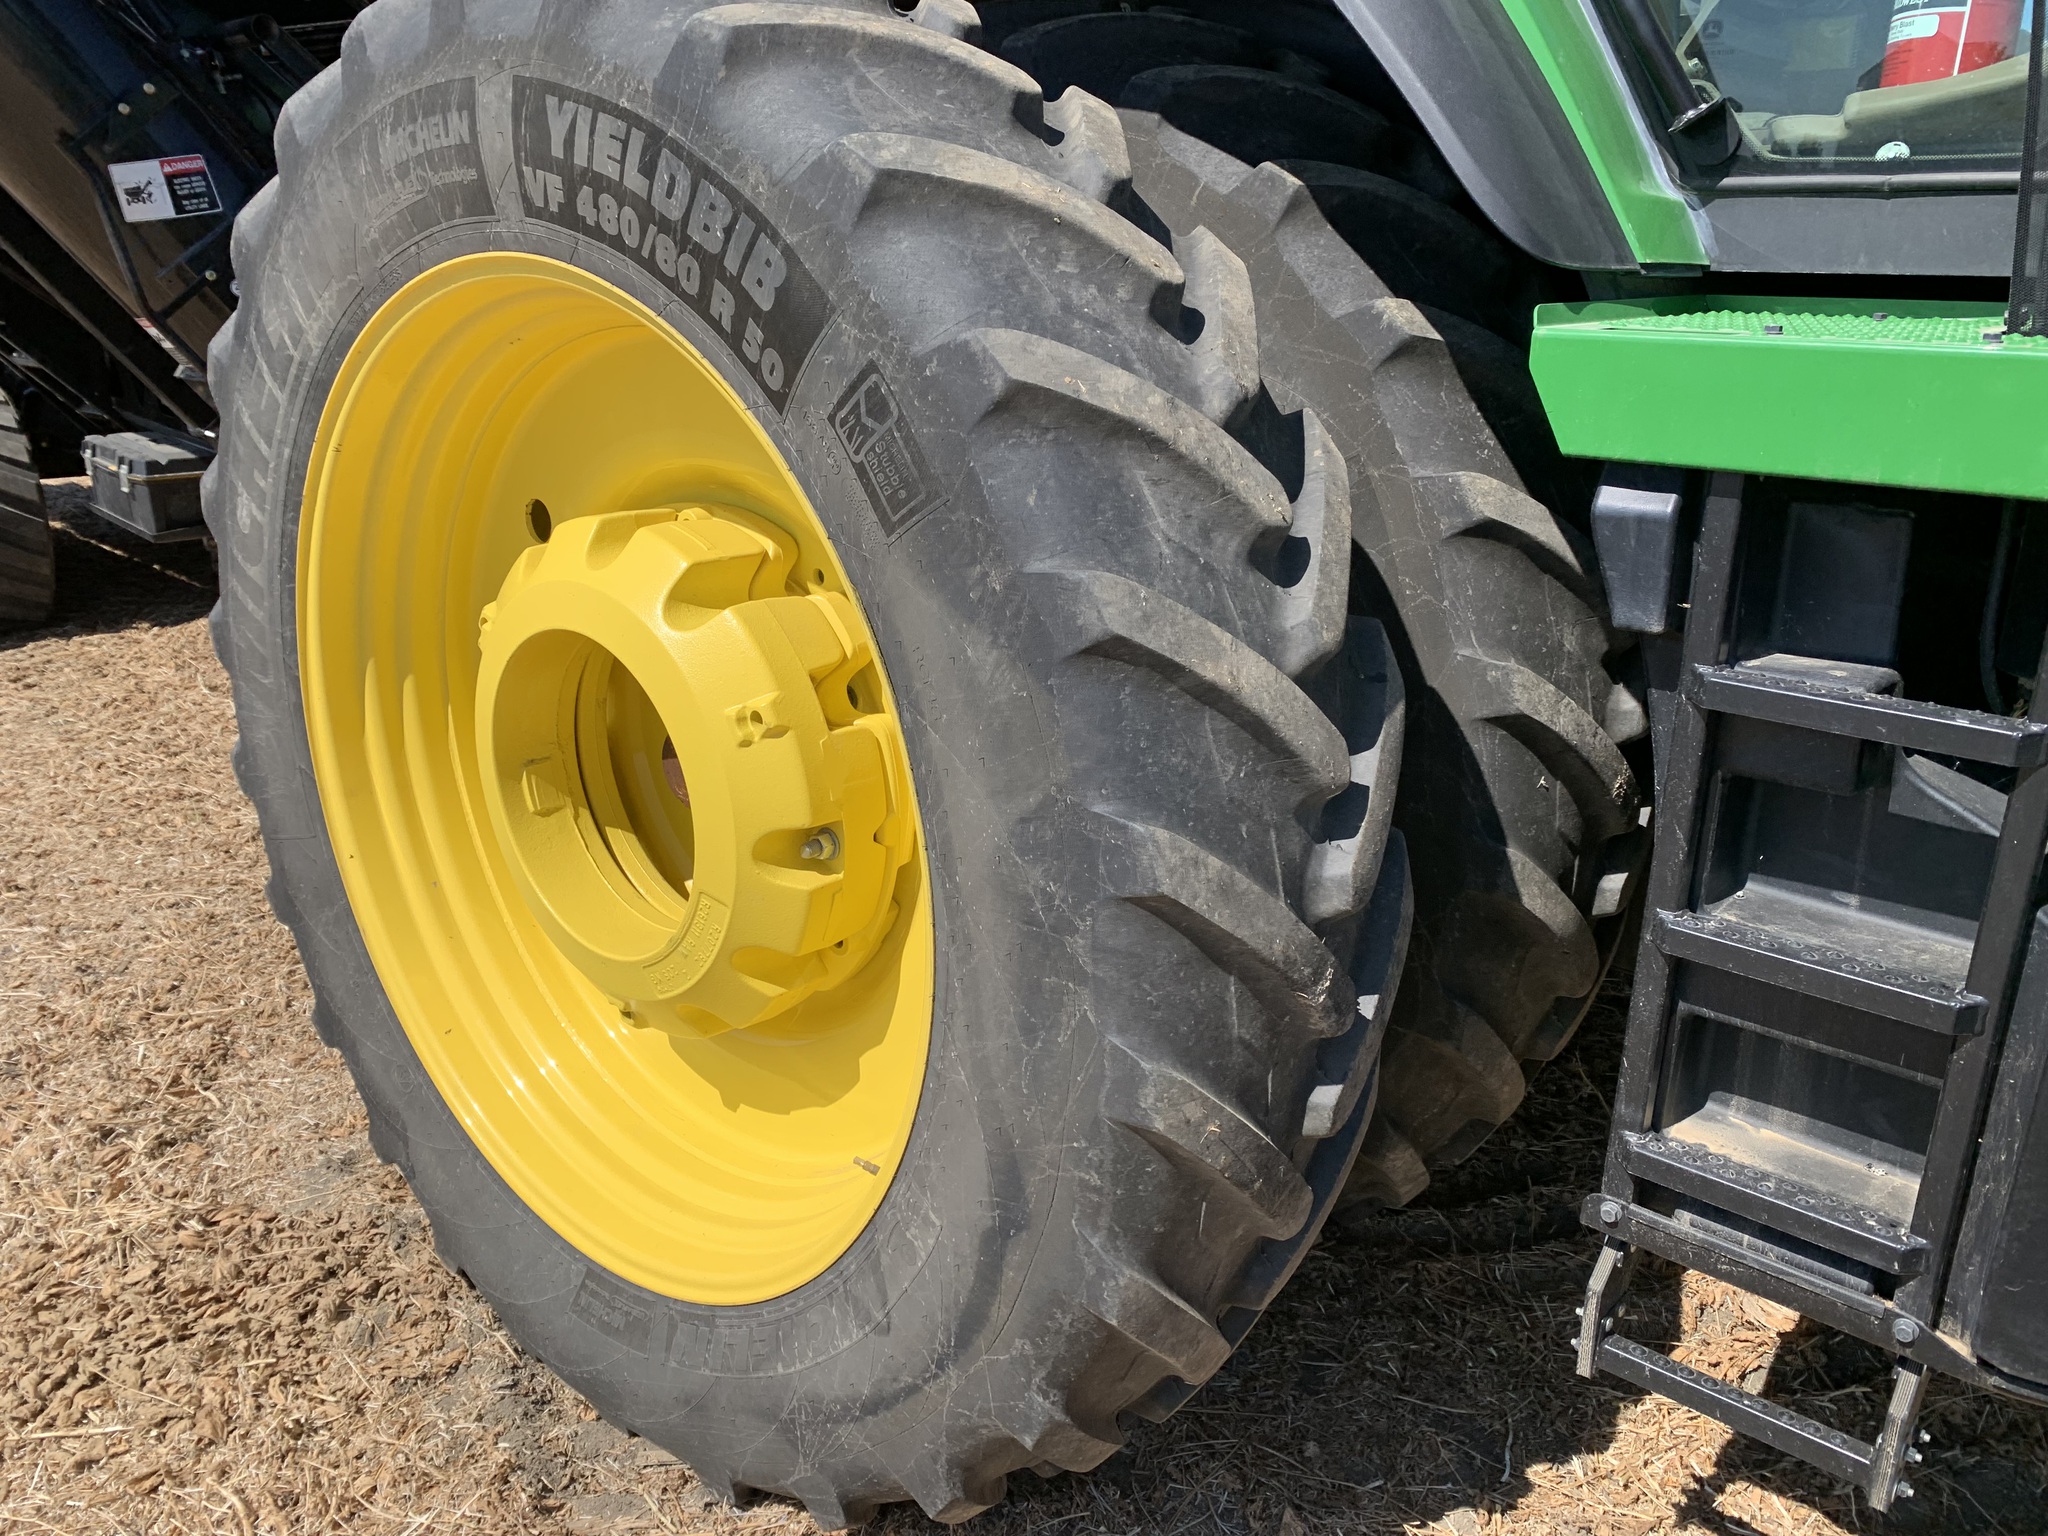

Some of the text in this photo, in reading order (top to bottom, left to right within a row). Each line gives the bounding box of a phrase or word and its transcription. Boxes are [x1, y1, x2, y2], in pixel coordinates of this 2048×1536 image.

[1900, 20, 1915, 28] Blast
[171, 159, 203, 171] DANGER
[544, 94, 787, 311] YIELDBIB
[523, 166, 785, 393] VF 480/80 R 50
[866, 450, 894, 497] shield
[875, 440, 907, 499] Stubble
[884, 431, 909, 479] MICHELIN
